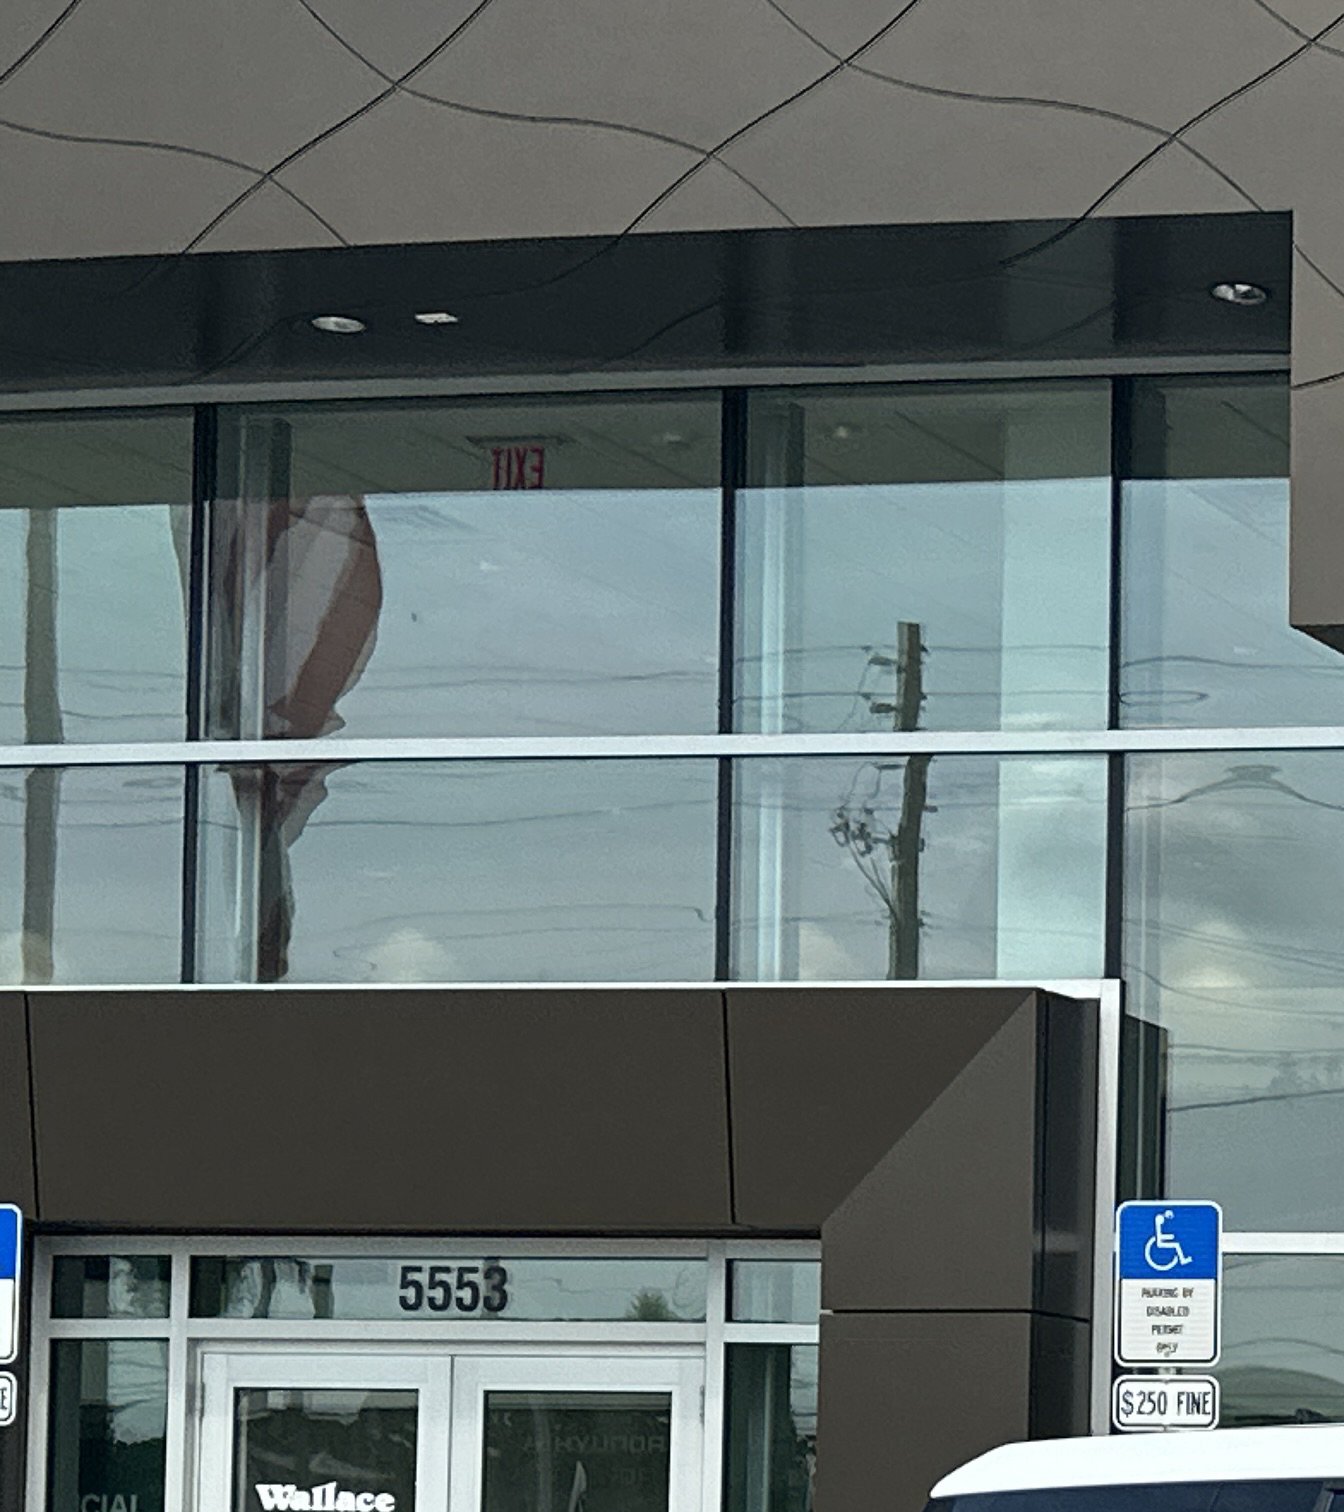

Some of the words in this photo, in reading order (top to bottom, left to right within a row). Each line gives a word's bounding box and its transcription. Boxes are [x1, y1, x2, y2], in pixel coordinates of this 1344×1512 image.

[399, 1265, 508, 1311] 5553
[1120, 1390, 1168, 1417] $250
[1177, 1391, 1212, 1417] FINE
